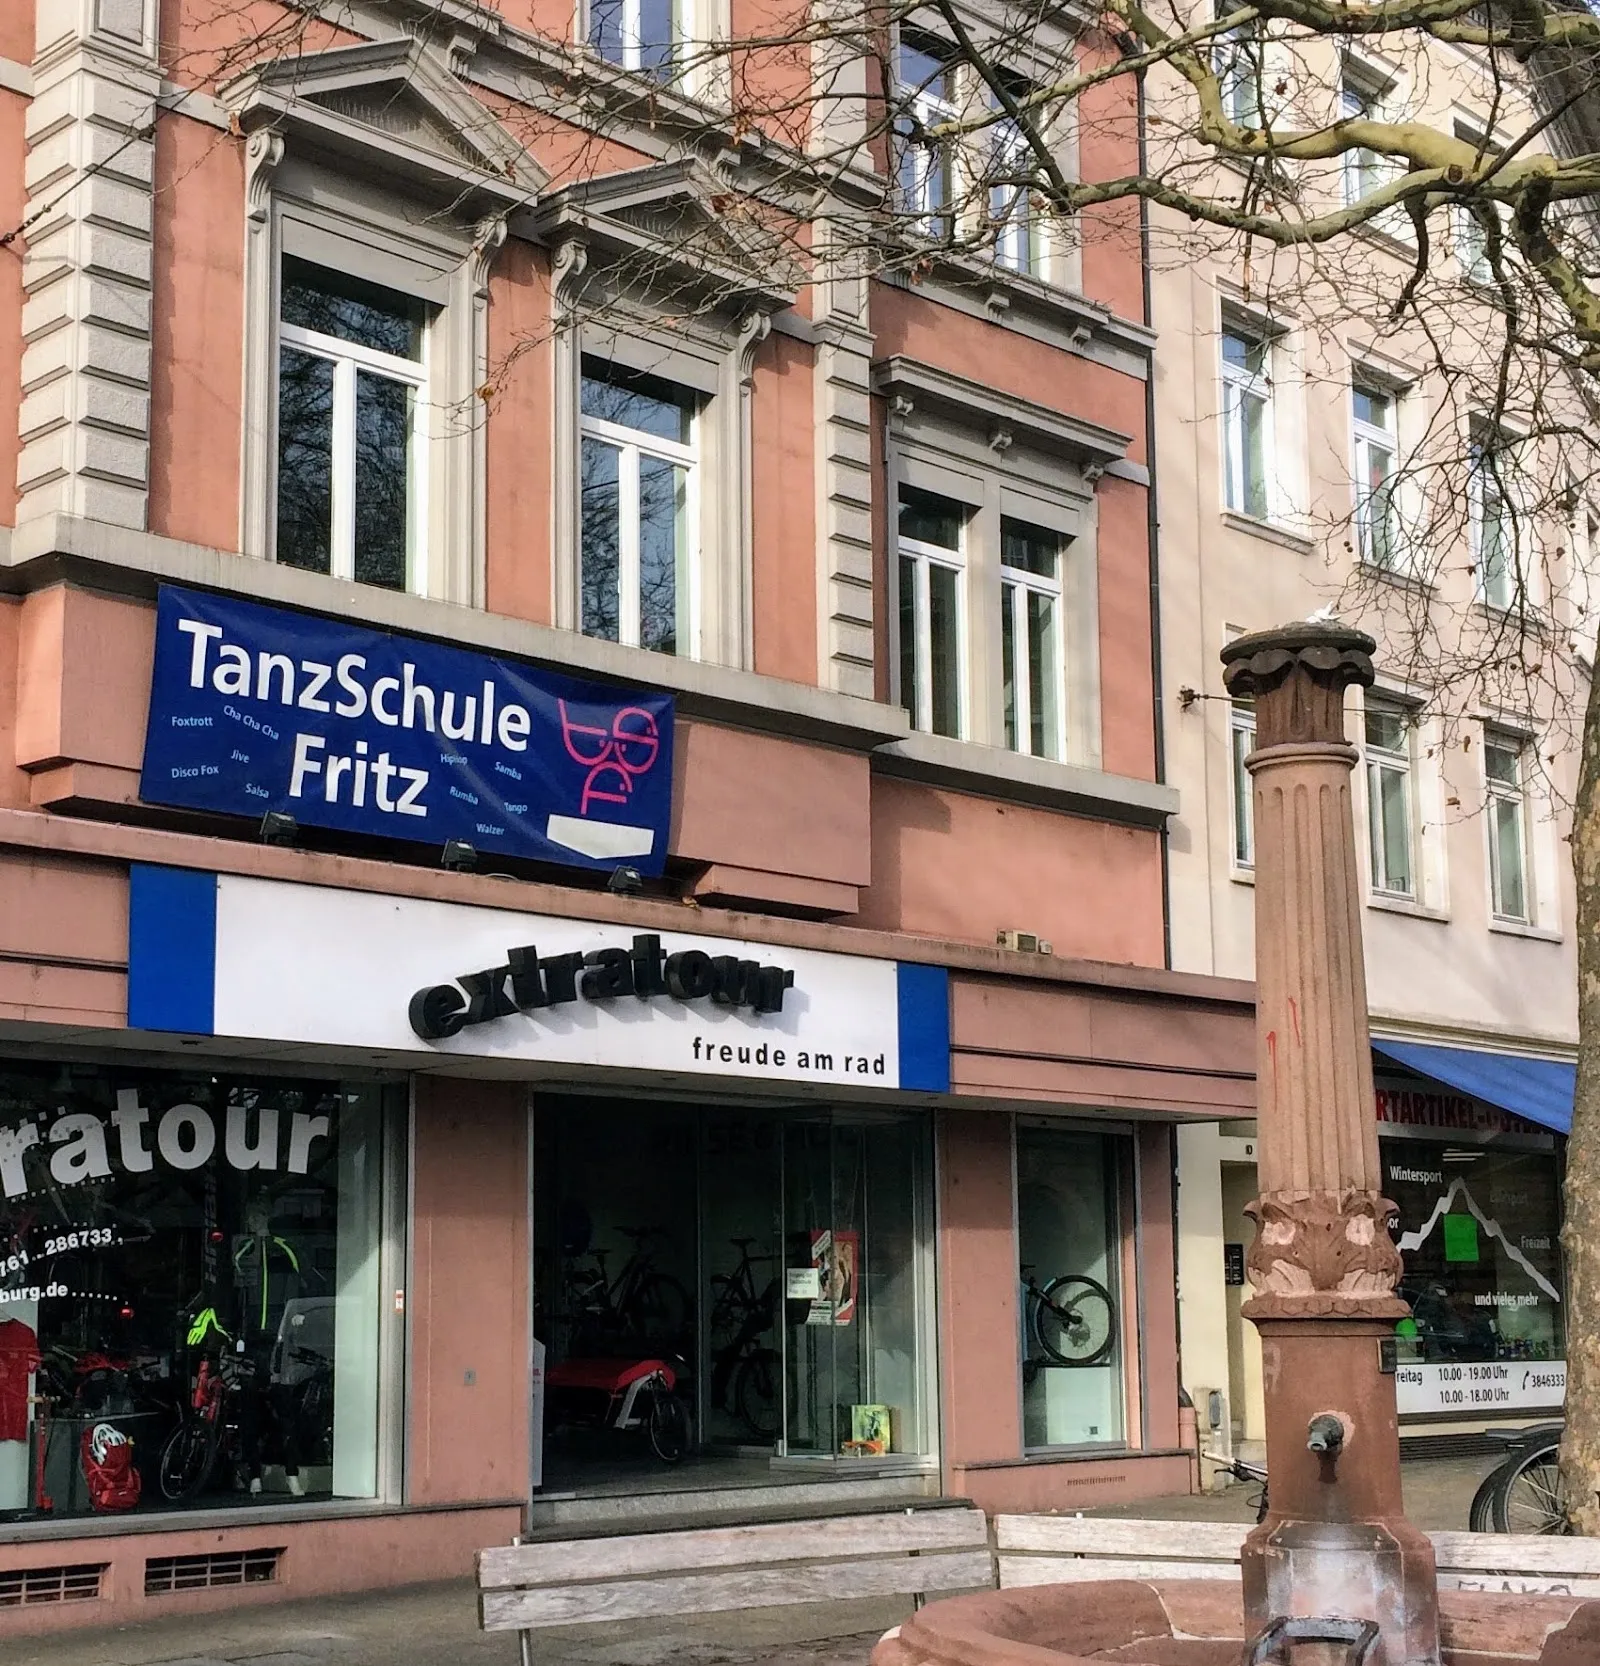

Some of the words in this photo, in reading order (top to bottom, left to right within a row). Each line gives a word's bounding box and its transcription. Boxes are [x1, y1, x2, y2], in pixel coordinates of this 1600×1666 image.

[177, 618, 531, 752] TanzSchule
[171, 716, 214, 727] Foxtrott
[223, 704, 242, 721] Cha
[242, 714, 261, 731] Cha
[261, 724, 280, 741] Cha
[230, 749, 250, 763] Jive
[171, 767, 199, 779] Disco
[200, 764, 220, 775] Fox
[289, 732, 429, 817] Fritz
[494, 761, 523, 781] Samba
[245, 783, 270, 799] Salsa
[449, 785, 479, 805] Rumba
[503, 801, 528, 814] Tango
[475, 822, 505, 836] Walzer
[408, 933, 795, 1040] extratour
[692, 1036, 786, 1067] freude
[797, 1051, 833, 1071] am
[844, 1053, 885, 1076] rad
[1390, 1165, 1443, 1186] Wintersport
[1474, 1291, 1492, 1306] und
[1492, 1291, 1516, 1306] vieles
[1517, 1291, 1539, 1306] mehr
[1438, 1367, 1462, 1381] 10.00
[1469, 1366, 1492, 1380] 19.00
[1493, 1365, 1509, 1379] Uhr
[1440, 1390, 1463, 1404] 10.00
[1470, 1389, 1493, 1403] 18.00
[1494, 1387, 1510, 1401] Uhr
